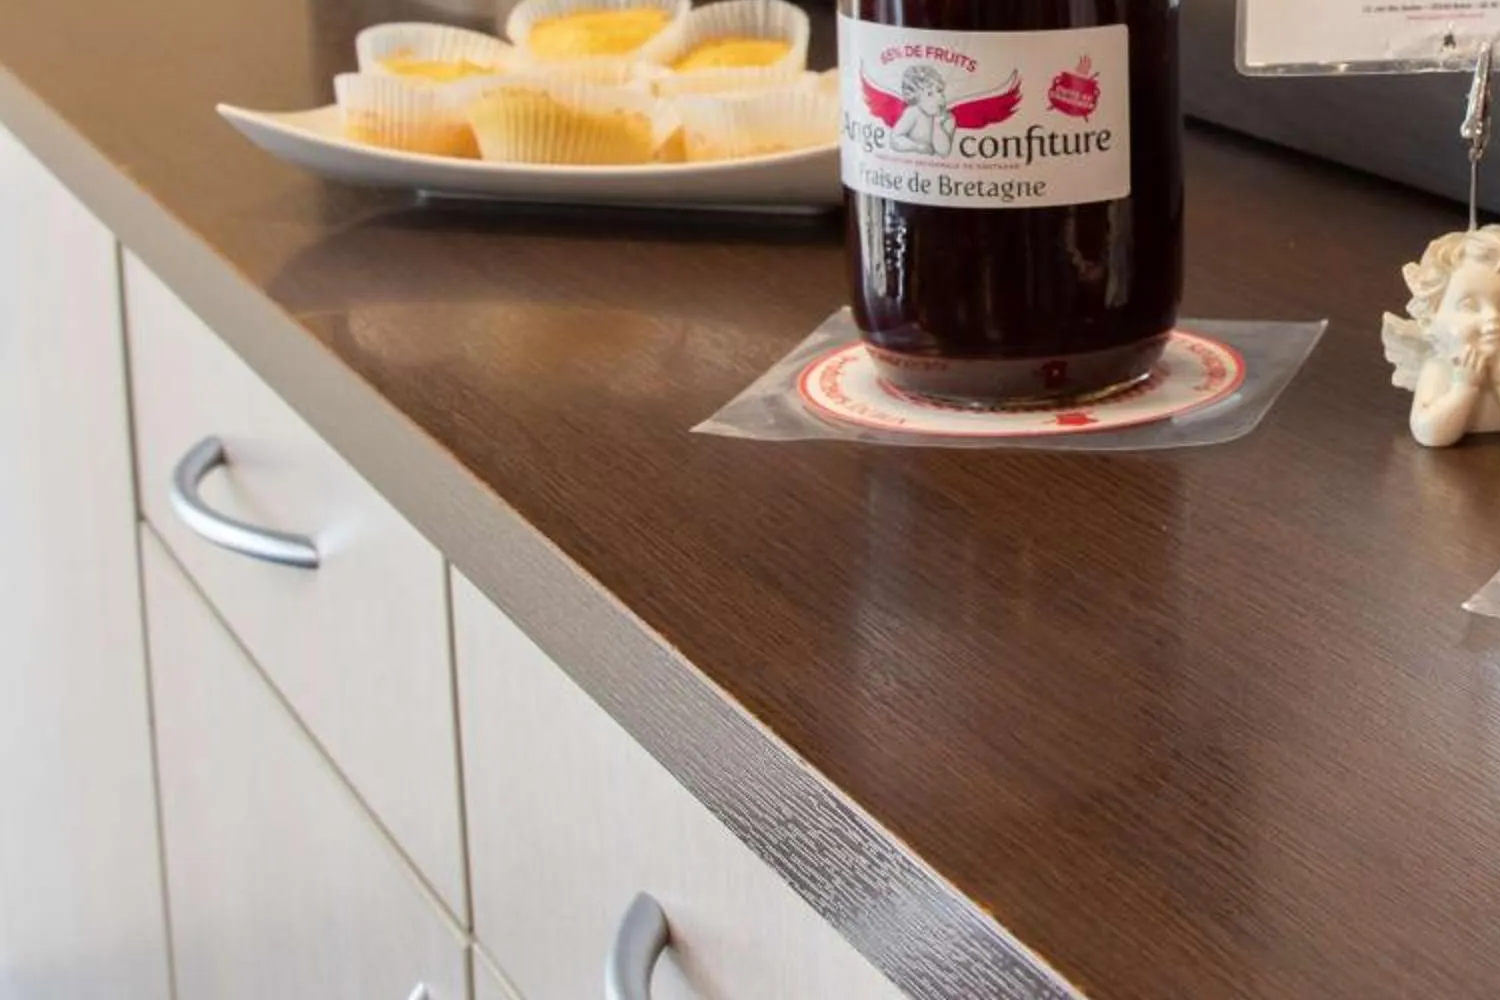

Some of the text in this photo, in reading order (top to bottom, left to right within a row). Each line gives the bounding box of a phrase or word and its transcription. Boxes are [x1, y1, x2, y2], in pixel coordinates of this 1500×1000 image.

[904, 45, 922, 58] DE
[925, 45, 978, 73] FRUITS
[958, 123, 1112, 166] confiture
[907, 171, 932, 194] de
[938, 173, 1047, 203] Bretagne
